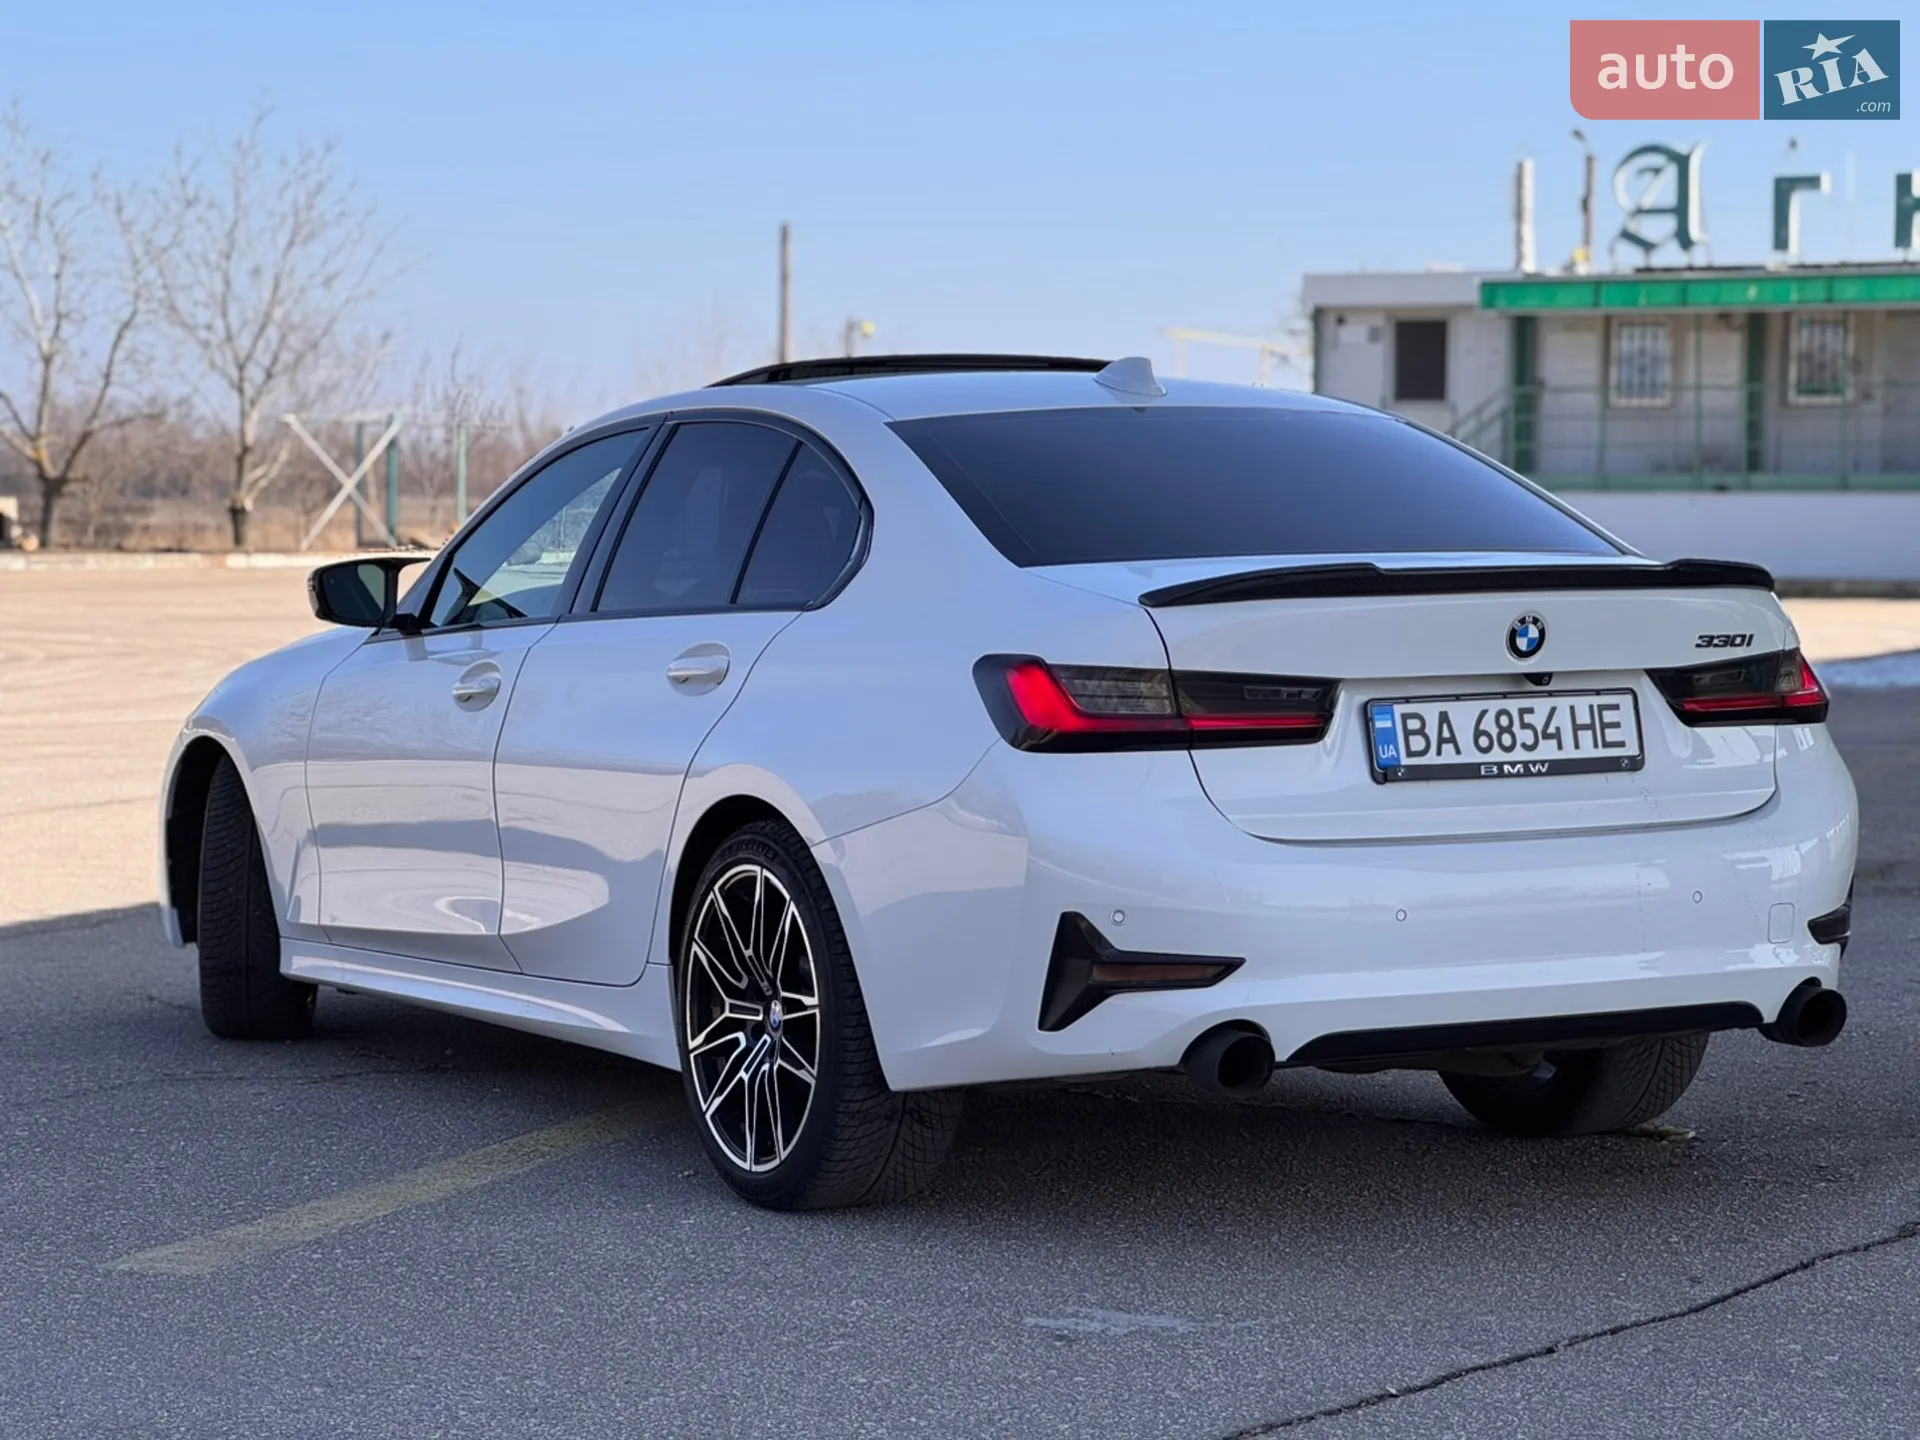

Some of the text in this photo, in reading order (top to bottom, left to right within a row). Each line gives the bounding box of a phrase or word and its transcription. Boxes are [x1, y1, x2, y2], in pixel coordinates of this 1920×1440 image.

[1400, 703, 1626, 758] BA 6854 HE
[1379, 744, 1398, 760] UA
[1480, 761, 1549, 776] BMW
